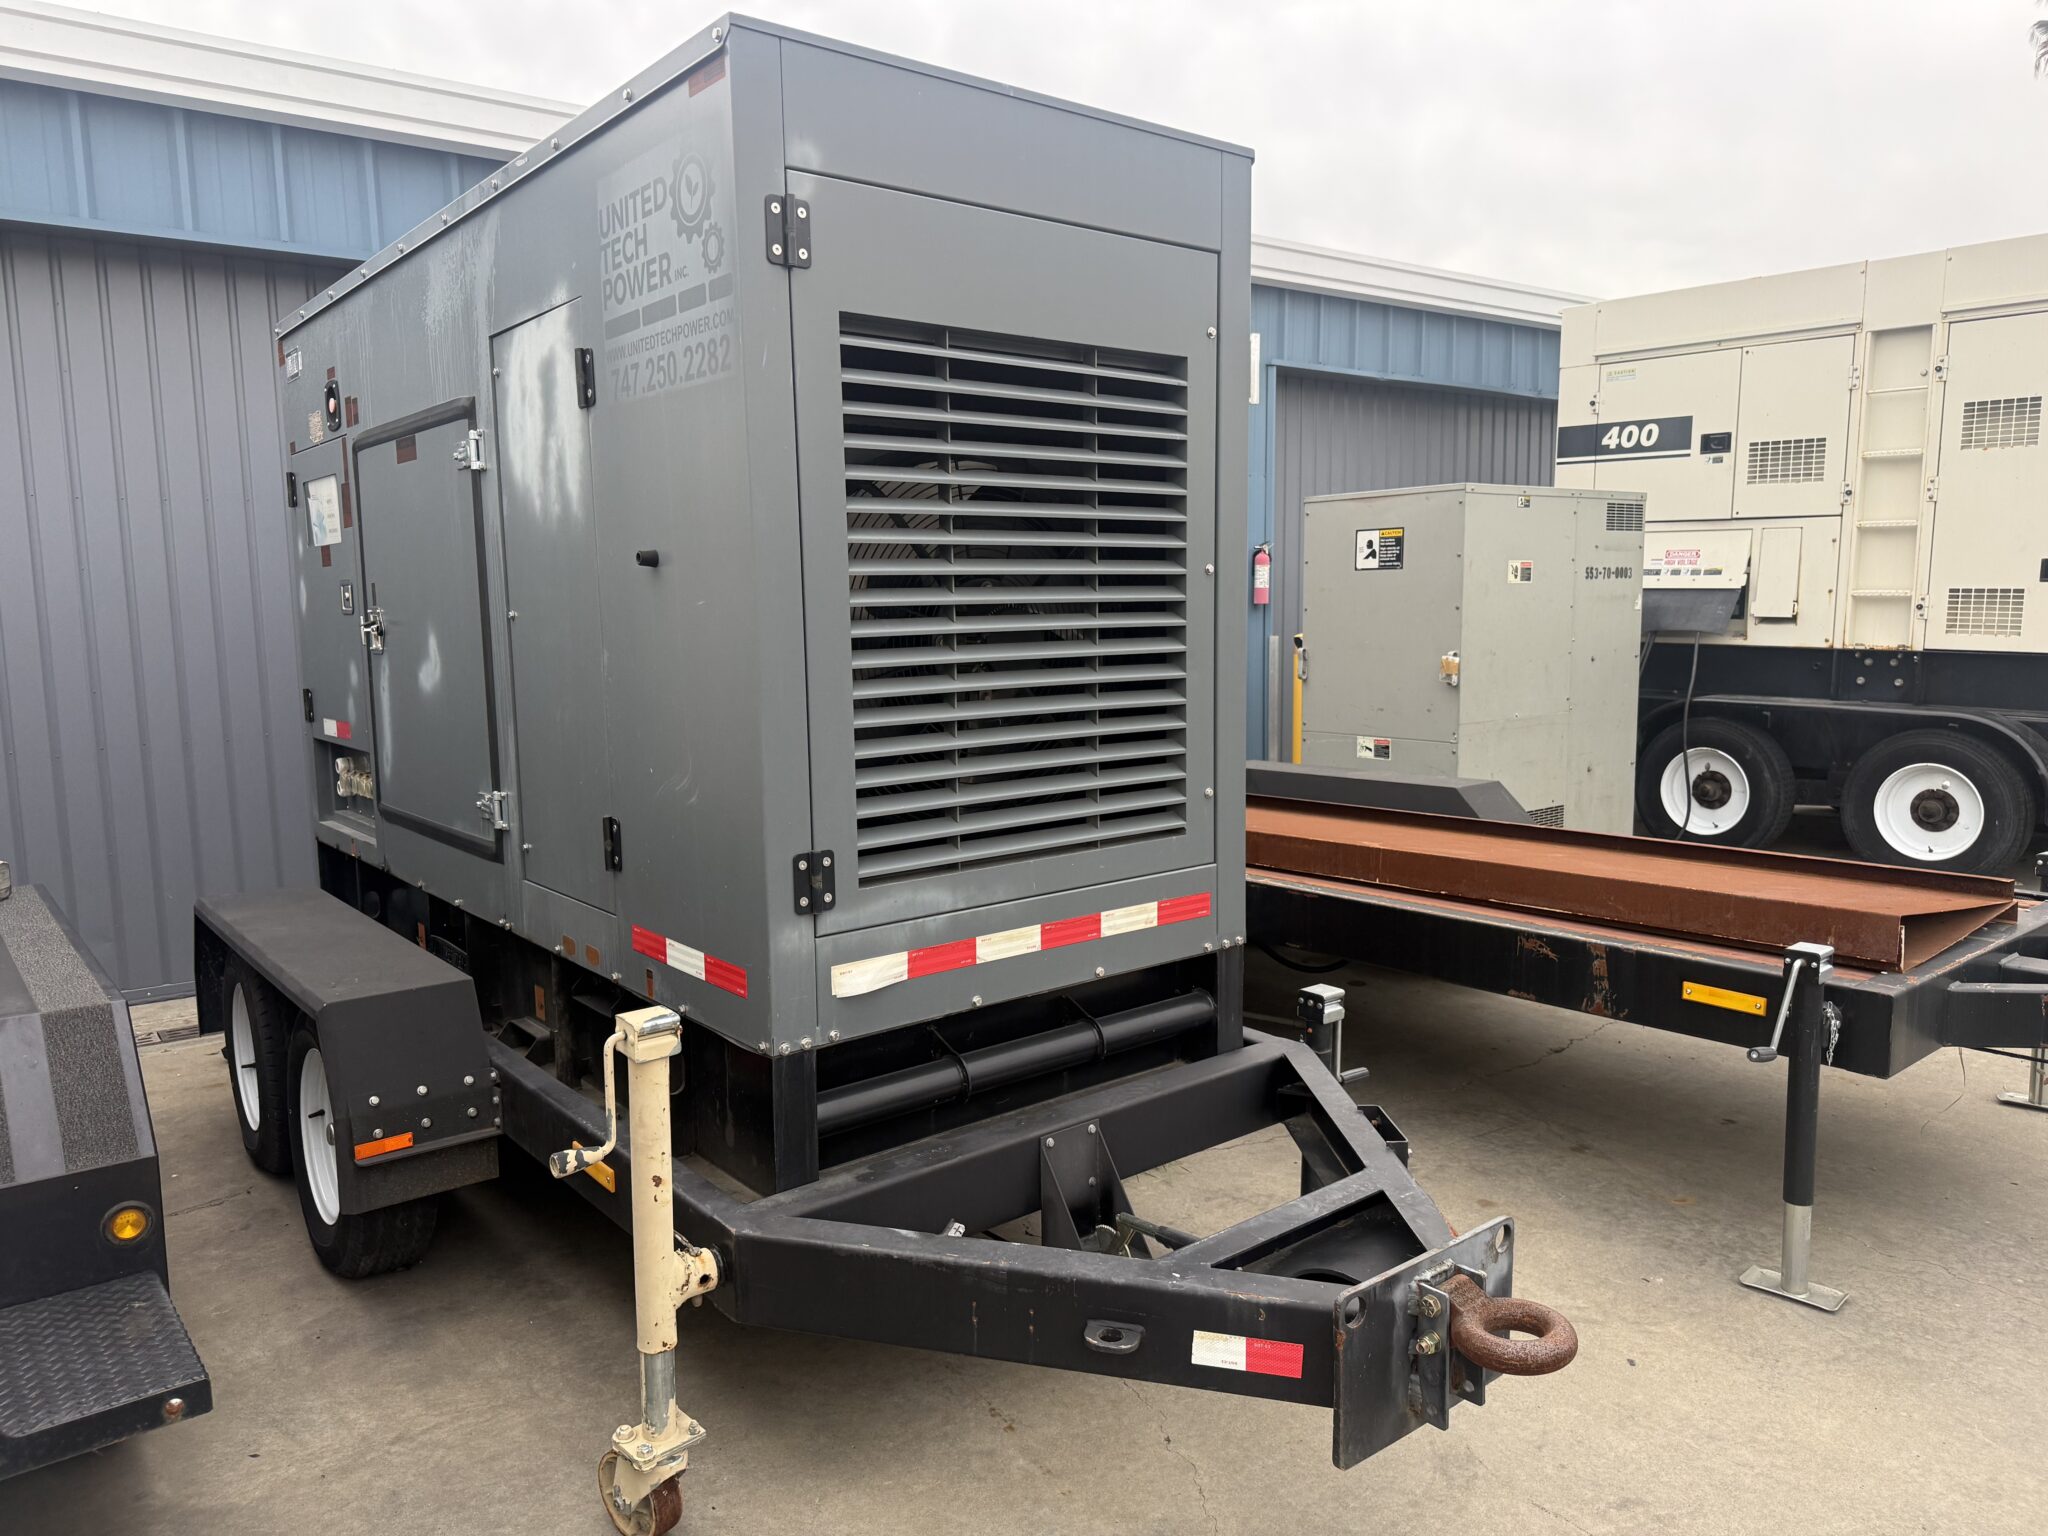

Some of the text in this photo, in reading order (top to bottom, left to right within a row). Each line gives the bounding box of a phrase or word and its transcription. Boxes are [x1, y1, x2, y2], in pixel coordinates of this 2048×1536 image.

[599, 176, 667, 239] UNITED
[599, 222, 648, 275] TECH
[602, 251, 690, 311] POWER INC.
[606, 307, 735, 364] WWW.UNITEDTECHPOWER.COM
[610, 334, 732, 403] 747.250.2282
[1601, 423, 1660, 449] 400
[1585, 566, 1633, 580] 553-70-0003
